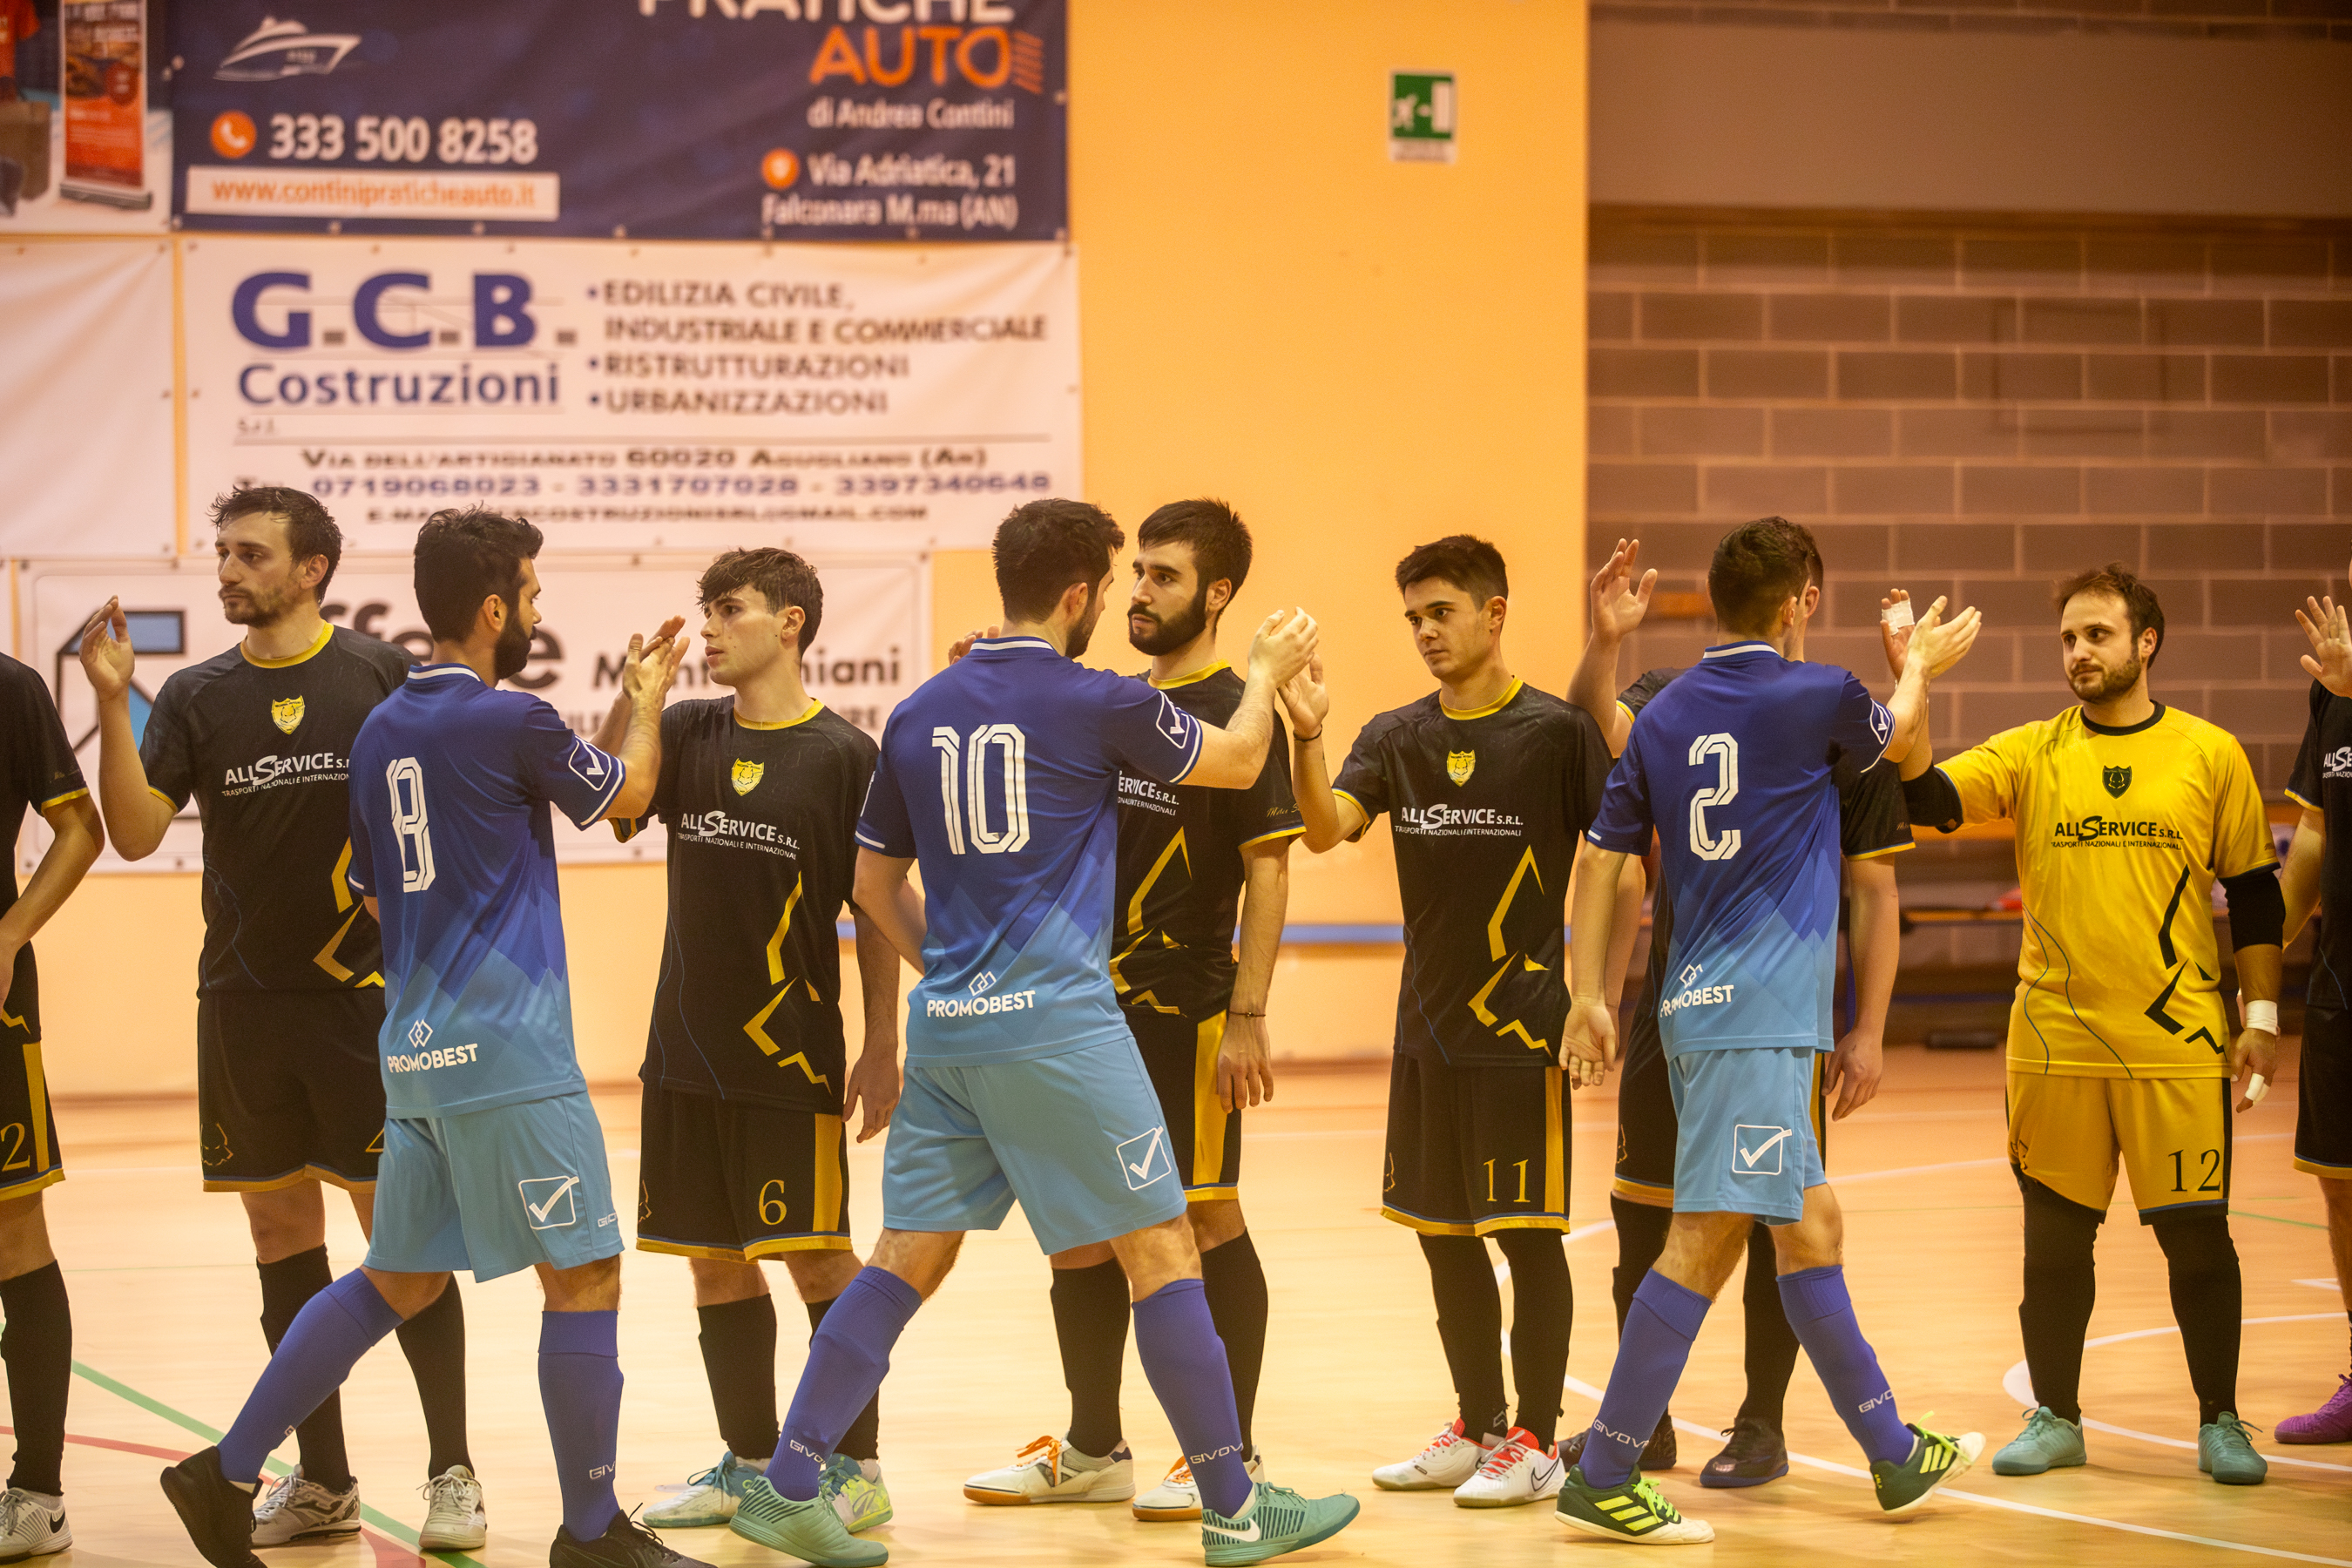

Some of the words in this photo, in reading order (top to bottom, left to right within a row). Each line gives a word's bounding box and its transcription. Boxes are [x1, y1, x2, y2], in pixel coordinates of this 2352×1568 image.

[808, 25, 1012, 86] AUTO
[807, 96, 835, 128] di
[835, 98, 924, 128] Andrea
[926, 98, 1015, 128] Contini
[269, 113, 345, 161] 333
[355, 116, 430, 162] 500
[437, 117, 538, 164] 8258
[807, 152, 852, 186] Via
[854, 152, 980, 190] Adriatica,
[983, 153, 1017, 187] 21
[212, 177, 536, 208] www.continipraticheauto.it
[761, 193, 882, 225] Falconara
[885, 193, 958, 225] M.ma
[960, 193, 1019, 231] (AN)
[231, 270, 578, 351] G.C.B.
[605, 280, 735, 306] EDILIZIA
[747, 281, 855, 311] CIVILE,
[605, 317, 796, 341] INDUSTRIALE
[809, 317, 822, 341] E
[835, 314, 1046, 341] COMMERCIALE
[605, 353, 909, 378] RISTRUTTURAZIONI
[239, 363, 559, 405] Costruzioni
[609, 390, 888, 414] URBANIZZAZIONI
[625, 448, 736, 468] 60020
[225, 753, 335, 786] ALLSERVICE
[931, 724, 1031, 855] 10
[1156, 791, 1179, 806] S.R.L.
[1688, 733, 1741, 861] 2
[386, 756, 436, 892] 8
[681, 810, 777, 841] ALLSERVICE
[778, 834, 801, 849] S.R.L.
[1401, 803, 1496, 829] ALLSERVICE
[1497, 814, 1524, 825] S.R.L.
[2055, 815, 2157, 841] ALLSERVICE
[705, 836, 740, 848] NAZIONALI
[927, 990, 1036, 1017] PROMOBEST
[387, 1043, 478, 1073] PROMOBEST
[1483, 1158, 1531, 1202] 11
[2168, 1149, 2220, 1193] 12
[759, 1179, 787, 1225] 6
[789, 1439, 826, 1464] GIVO
[1190, 1443, 1244, 1464] GIVOV
